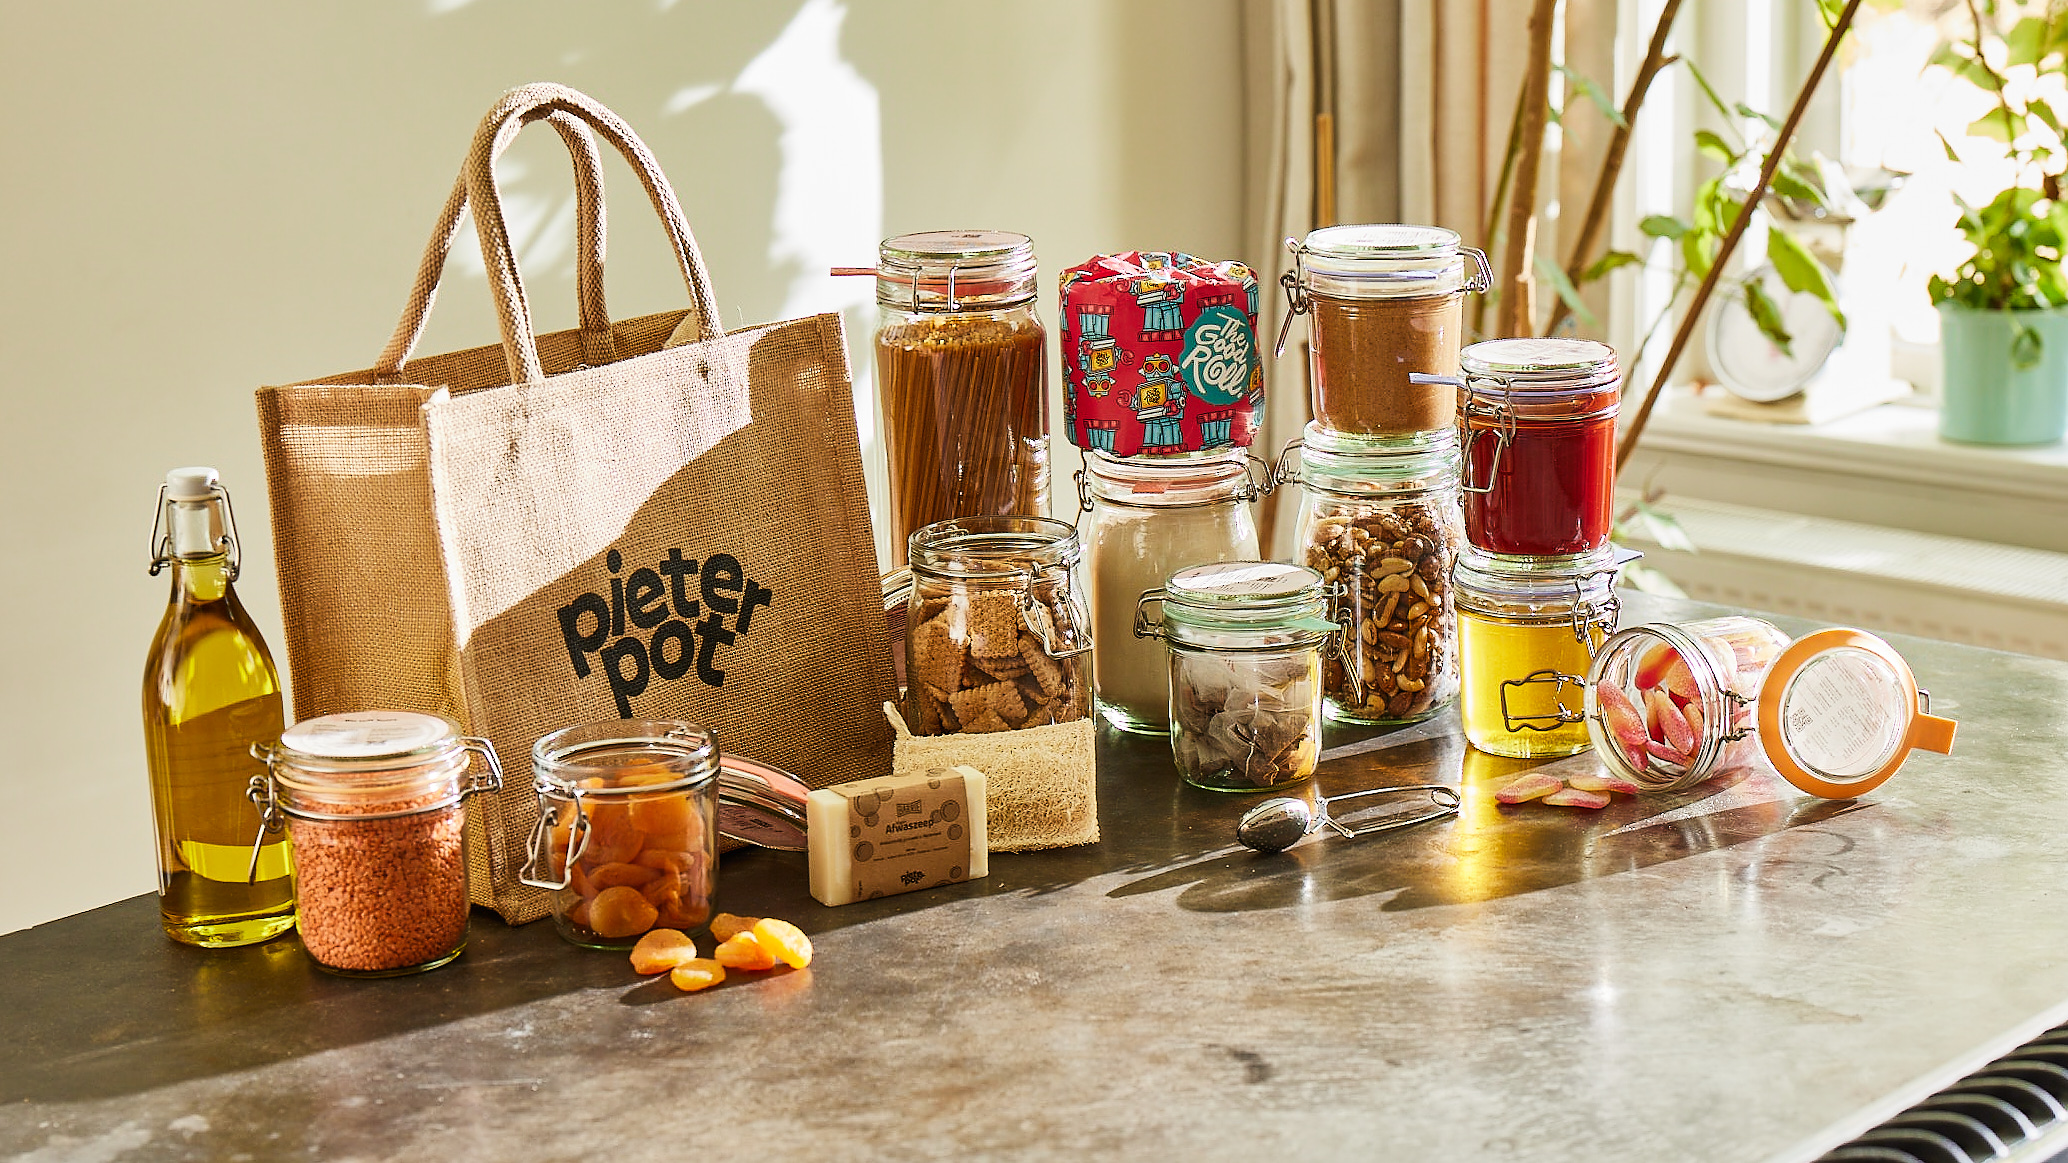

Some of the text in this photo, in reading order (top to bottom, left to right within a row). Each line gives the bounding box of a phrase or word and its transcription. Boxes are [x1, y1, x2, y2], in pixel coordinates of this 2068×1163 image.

[1195, 324, 1249, 364] Good
[1216, 312, 1246, 346] The
[557, 548, 773, 679] pieter
[600, 612, 736, 719] pot
[885, 819, 934, 835] Afwaszeep
